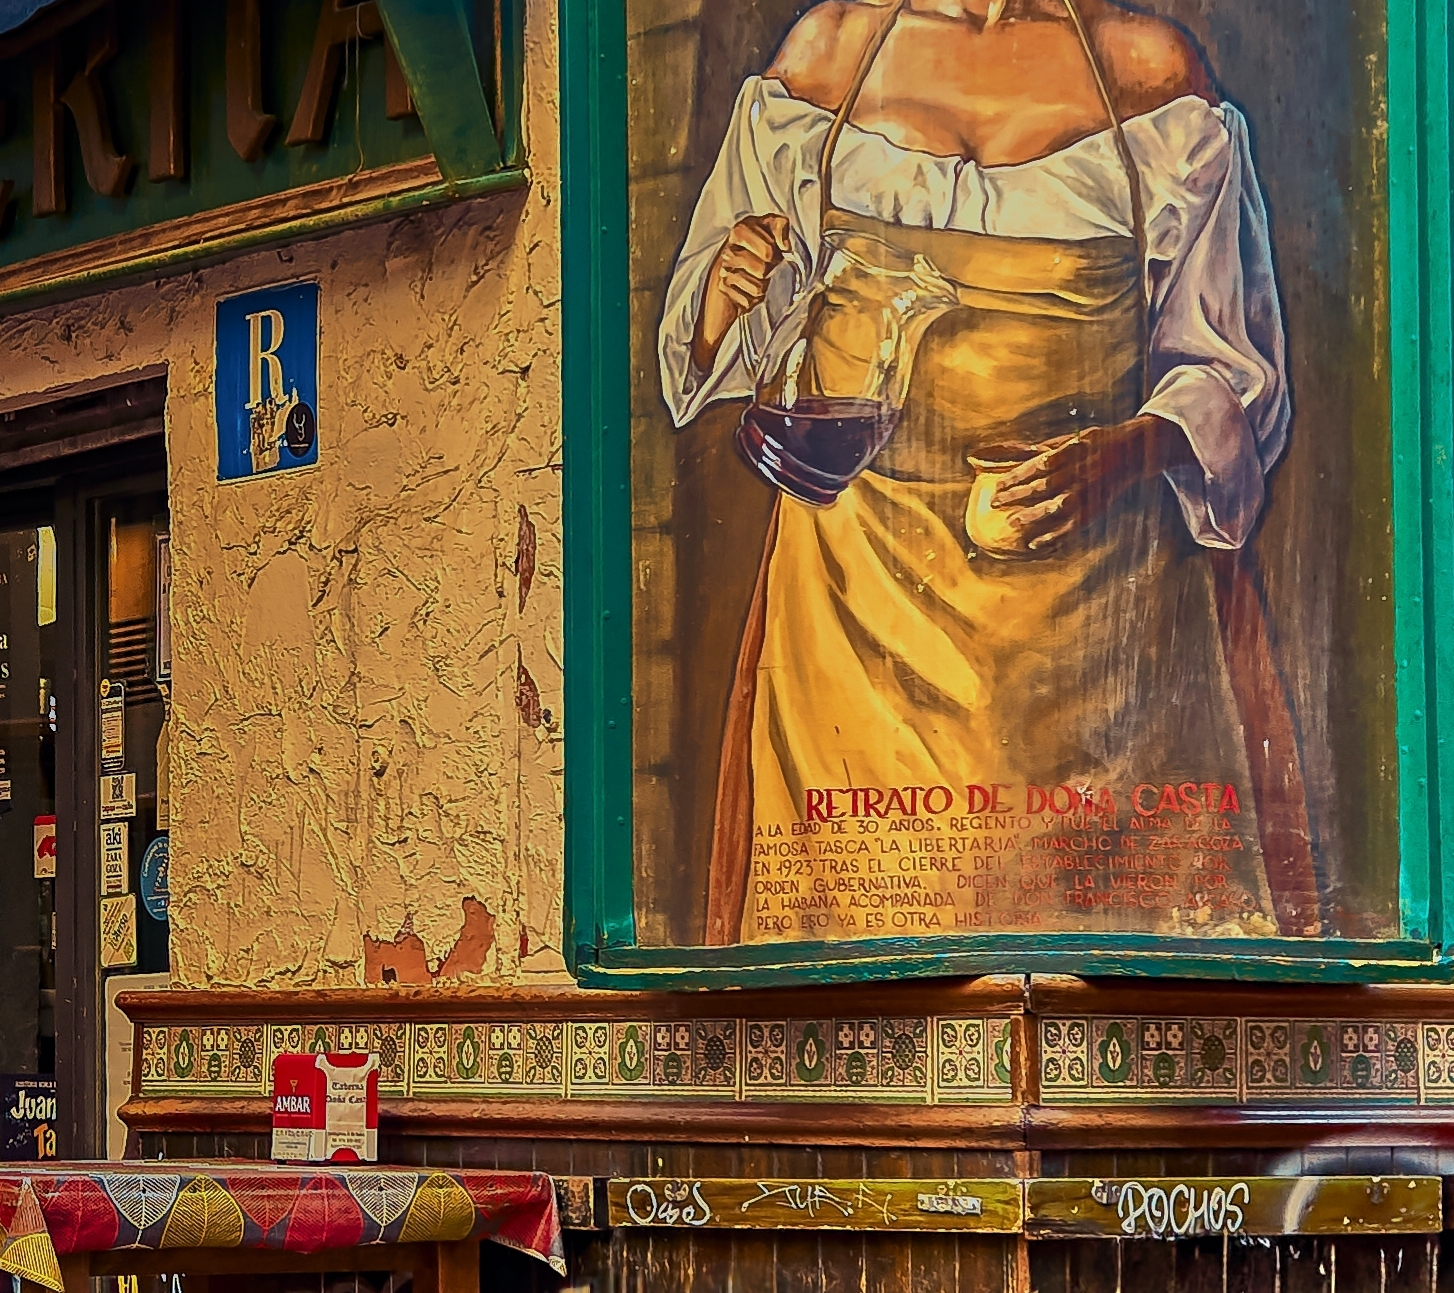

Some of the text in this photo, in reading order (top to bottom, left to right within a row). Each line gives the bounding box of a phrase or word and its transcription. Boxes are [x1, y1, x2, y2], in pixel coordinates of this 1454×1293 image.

[245, 309, 290, 410] R
[805, 785, 954, 823] RETRATO
[965, 783, 1014, 815] DE
[1131, 782, 1240, 816] CASTA
[755, 825, 764, 837] A
[767, 823, 783, 837] LA
[791, 821, 821, 836] EDAD
[831, 820, 849, 834] DE
[857, 820, 879, 834] 30
[888, 817, 941, 832] AÑOS.
[950, 816, 1032, 831] REGENTO
[753, 841, 810, 857] FAMOSA
[815, 839, 871, 855] TASCA
[753, 861, 770, 876] EN
[819, 859, 859, 874] TRAS
[868, 859, 885, 873] EL
[898, 857, 962, 872] CIERRE
[755, 880, 800, 895] ORDEN
[813, 875, 928, 893] GUBERNATIVA.
[957, 874, 1008, 889] DICEN
[756, 897, 770, 912] LA
[781, 895, 840, 911] HABANA
[849, 891, 955, 909] ACOMPAÑADA
[756, 915, 792, 931] PERO
[838, 912, 856, 927] YA
[865, 912, 885, 928] ES
[892, 911, 941, 927] OTRA
[275, 1096, 311, 1113] AMBAR
